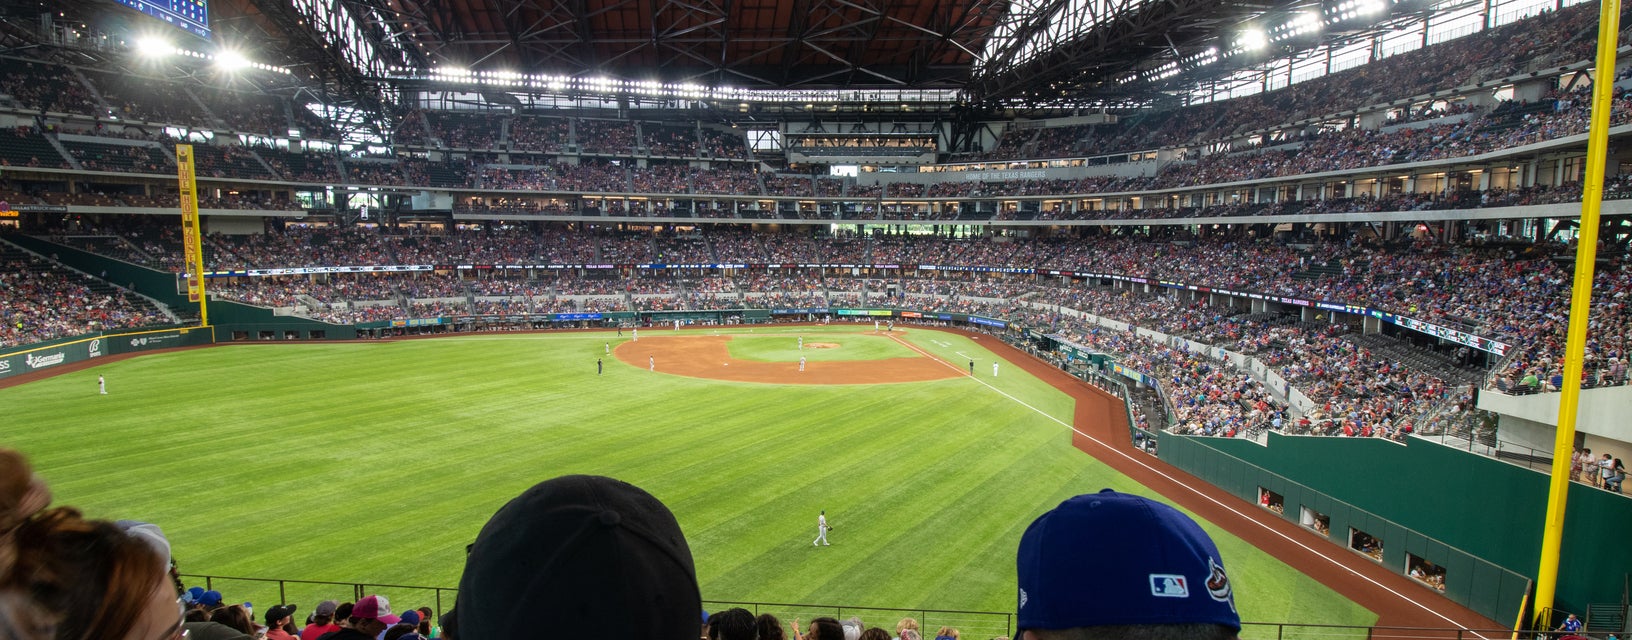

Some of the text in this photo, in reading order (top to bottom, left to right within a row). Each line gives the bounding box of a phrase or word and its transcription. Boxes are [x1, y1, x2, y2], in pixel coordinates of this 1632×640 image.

[982, 172, 990, 180] OF
[1002, 171, 1019, 179] TEXAS
[1019, 170, 1046, 178] RANGERS
[186, 228, 195, 262] ZONE
[37, 352, 65, 363] Germania
